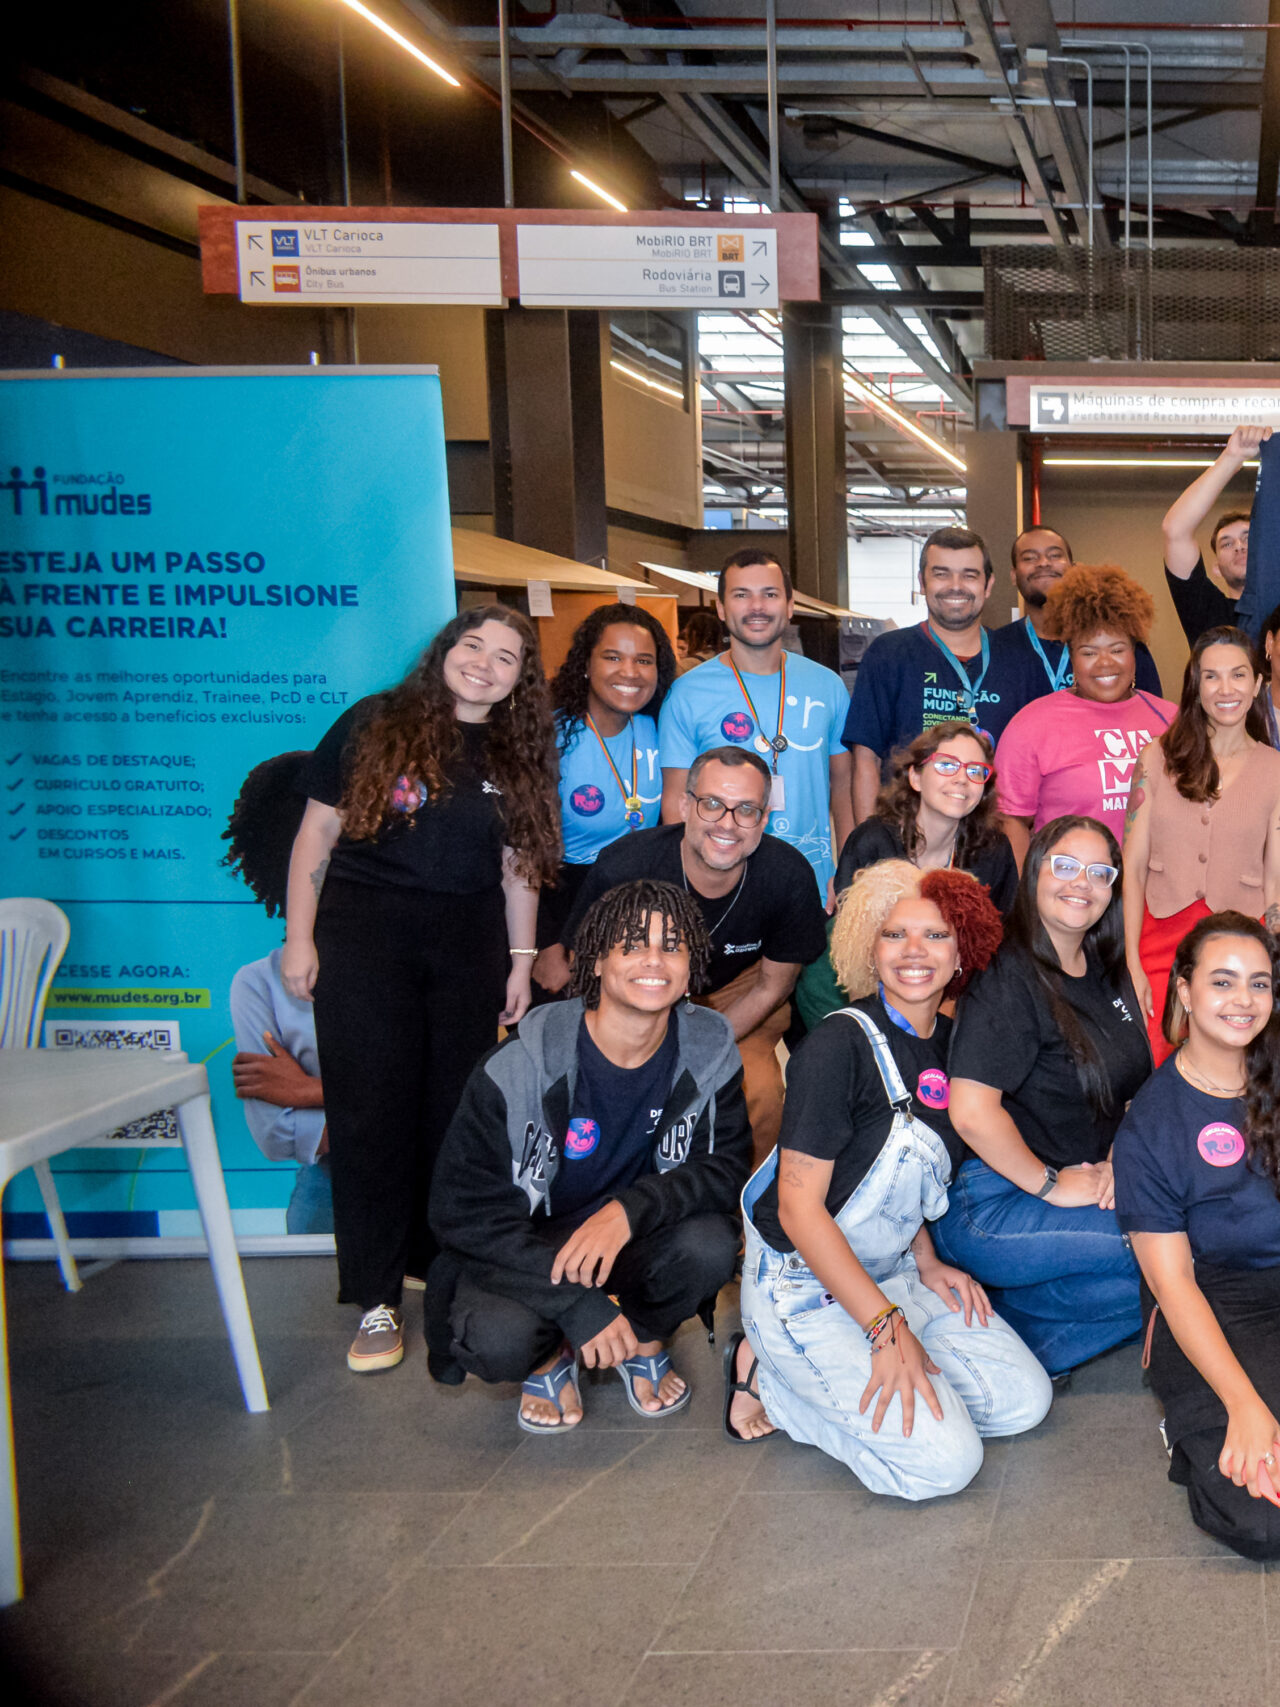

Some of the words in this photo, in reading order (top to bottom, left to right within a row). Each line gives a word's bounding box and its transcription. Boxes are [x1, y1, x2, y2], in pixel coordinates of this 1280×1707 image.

[304, 229, 328, 241] VLT
[333, 229, 384, 241] Carioca
[636, 235, 685, 247] MobiRIO
[689, 236, 713, 247] BRT
[305, 244, 321, 253] VLT
[326, 244, 362, 253] Carioca
[652, 249, 691, 259] MobiRIO
[694, 249, 712, 259] BRT
[722, 253, 739, 261] BRT
[305, 265, 336, 276] Ônibus
[339, 267, 376, 276] urbanos
[642, 268, 712, 281] Rodoviária
[327, 280, 344, 289] Bus
[659, 284, 677, 293] Bus
[680, 284, 712, 293] Station
[1073, 391, 1143, 409] Máquinas
[1149, 394, 1166, 406] de
[1171, 397, 1226, 409] compra
[1231, 398, 1239, 407] e
[53, 472, 125, 485] FUNDAÇÃO
[56, 486, 152, 515] mudes
[0, 552, 103, 574] ESTEJA
[112, 552, 156, 574] UM
[165, 552, 266, 574] PASSO
[24, 584, 139, 606] FRENTE
[149, 584, 166, 606] E
[175, 584, 359, 607] IMPULSIONE
[0, 616, 56, 638] SUA
[66, 616, 227, 639] CARREIRA!
[75, 672, 92, 683] as
[97, 670, 168, 684] melhores
[173, 671, 288, 686] oportunidades
[293, 674, 327, 687] para
[66, 690, 118, 703] Jovem
[270, 691, 301, 704] PcD
[306, 694, 315, 704] e
[320, 692, 348, 704] CLT
[17, 710, 58, 722] tenha
[63, 711, 117, 722] acesso
[121, 713, 130, 722] a
[221, 710, 306, 724] exclusivos:
[32, 755, 81, 766] VAGAS
[87, 755, 109, 766] DE
[113, 755, 196, 768] DESTAQUE;
[34, 778, 121, 791] CURRÍCULO
[36, 804, 83, 816] APOIO
[37, 829, 130, 841] DESCONTOS
[39, 848, 60, 859] EM
[63, 848, 127, 860] CURSOS
[131, 848, 138, 859] E
[143, 848, 186, 860] MAIS.
[56, 965, 112, 979] CESSE
[118, 965, 190, 979] AGORA:
[54, 992, 202, 1006] www.mudes.org.br
